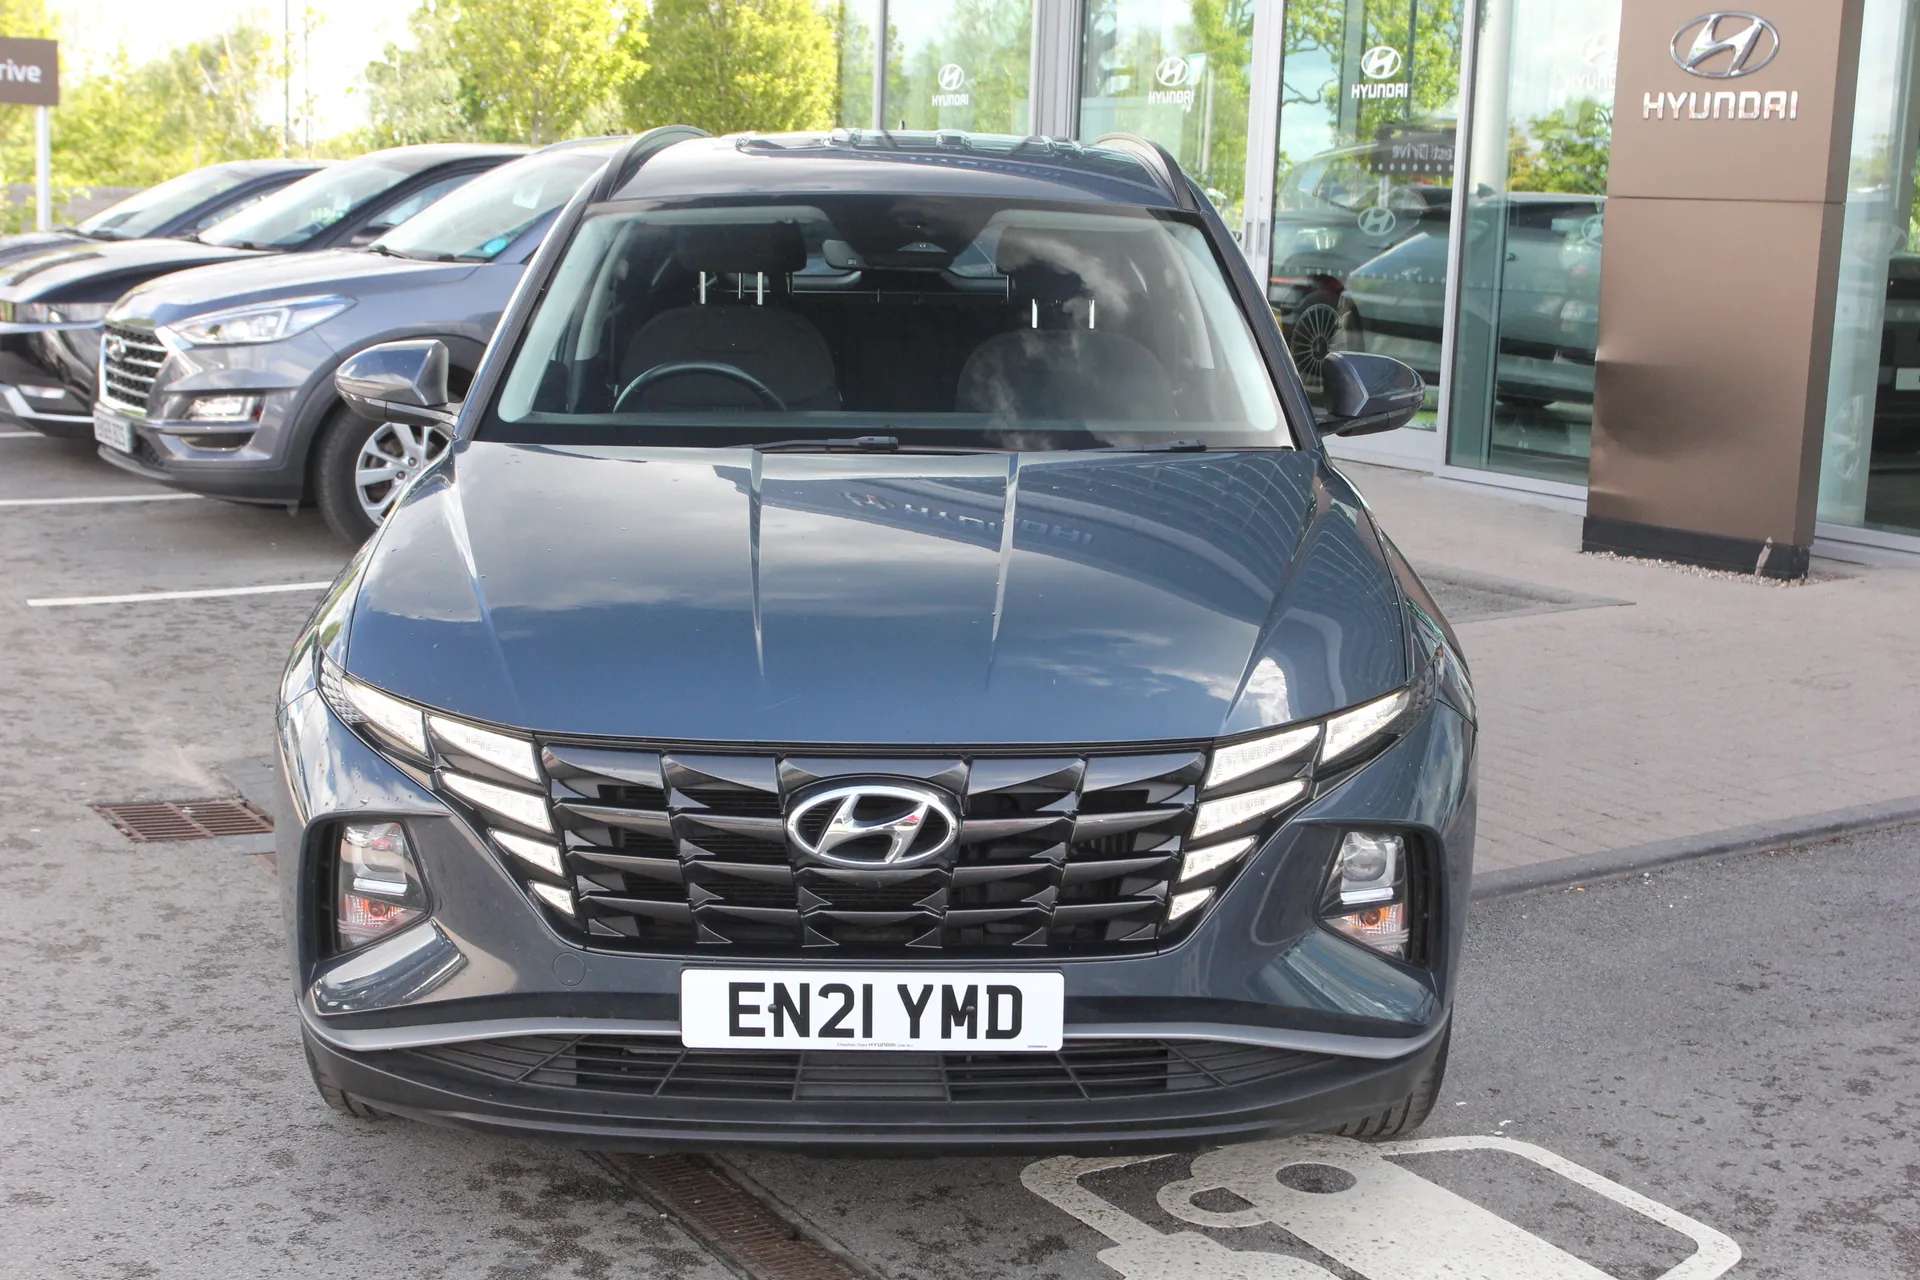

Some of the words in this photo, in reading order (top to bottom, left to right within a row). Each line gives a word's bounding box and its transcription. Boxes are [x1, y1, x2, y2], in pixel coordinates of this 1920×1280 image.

[0, 59, 42, 82] rive
[931, 94, 969, 106] HYUNDAI
[1148, 90, 1195, 104] HYUNDAI
[1351, 82, 1409, 99] HYUNDAI
[1643, 90, 1799, 120] HYUNDAI
[729, 982, 873, 1038] EN21
[897, 984, 1023, 1039] YMD
